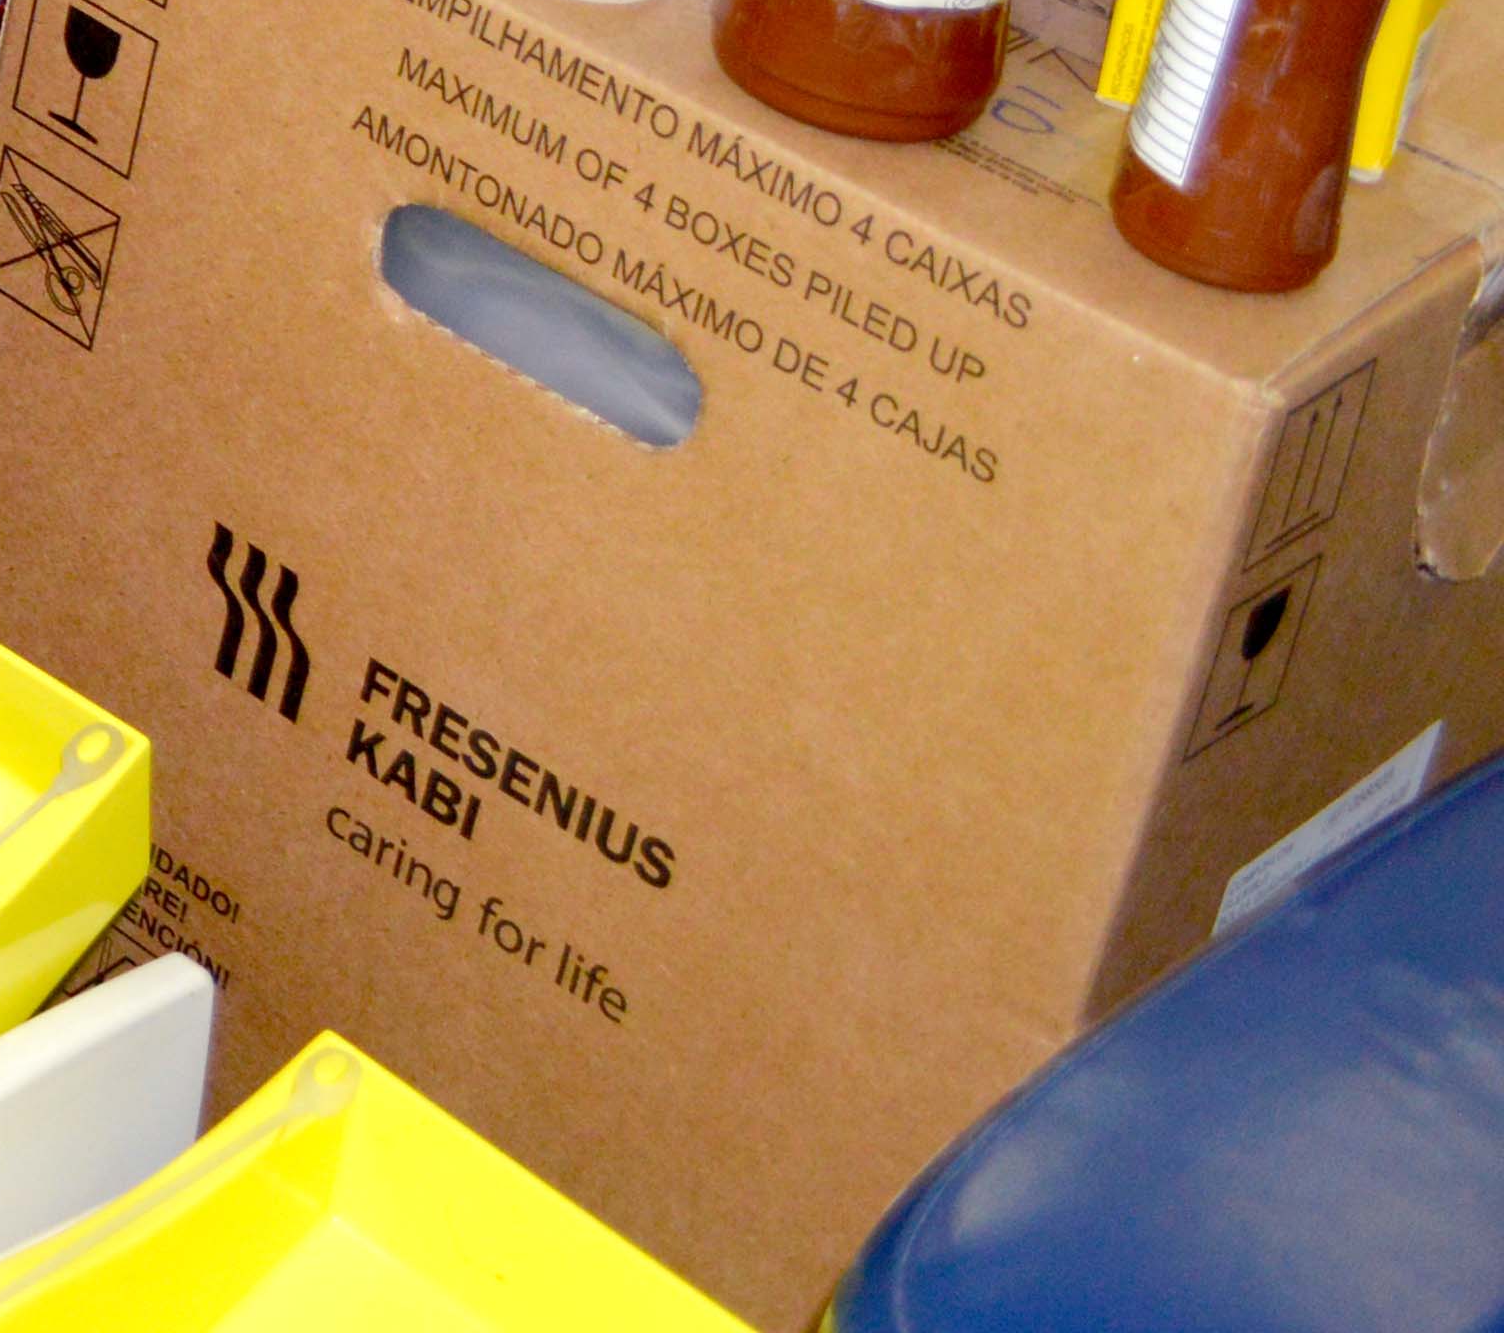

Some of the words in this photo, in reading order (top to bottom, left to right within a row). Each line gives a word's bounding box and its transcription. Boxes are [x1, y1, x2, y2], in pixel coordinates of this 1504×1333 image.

[351, 104, 604, 265] AMONTONADO
[612, 248, 765, 354] MÁXIMO
[772, 337, 830, 393] DE
[835, 376, 860, 408] 4
[869, 391, 999, 484] CAJAS
[397, 46, 568, 164] MAXIMUM
[575, 147, 629, 191] OF
[633, 181, 657, 213] 4
[663, 193, 796, 288] BOXES
[804, 269, 918, 353] PILED
[929, 337, 986, 383] UP
[687, 120, 842, 228] MÁXIMO
[849, 213, 876, 246] 4
[885, 229, 1033, 330] CAIXAS
[345, 717, 482, 841] KABI
[359, 656, 677, 890] FRESENIUS
[149, 842, 240, 924] IDADO!
[325, 806, 462, 921] caring
[477, 896, 547, 966] for
[554, 941, 629, 1025] life
